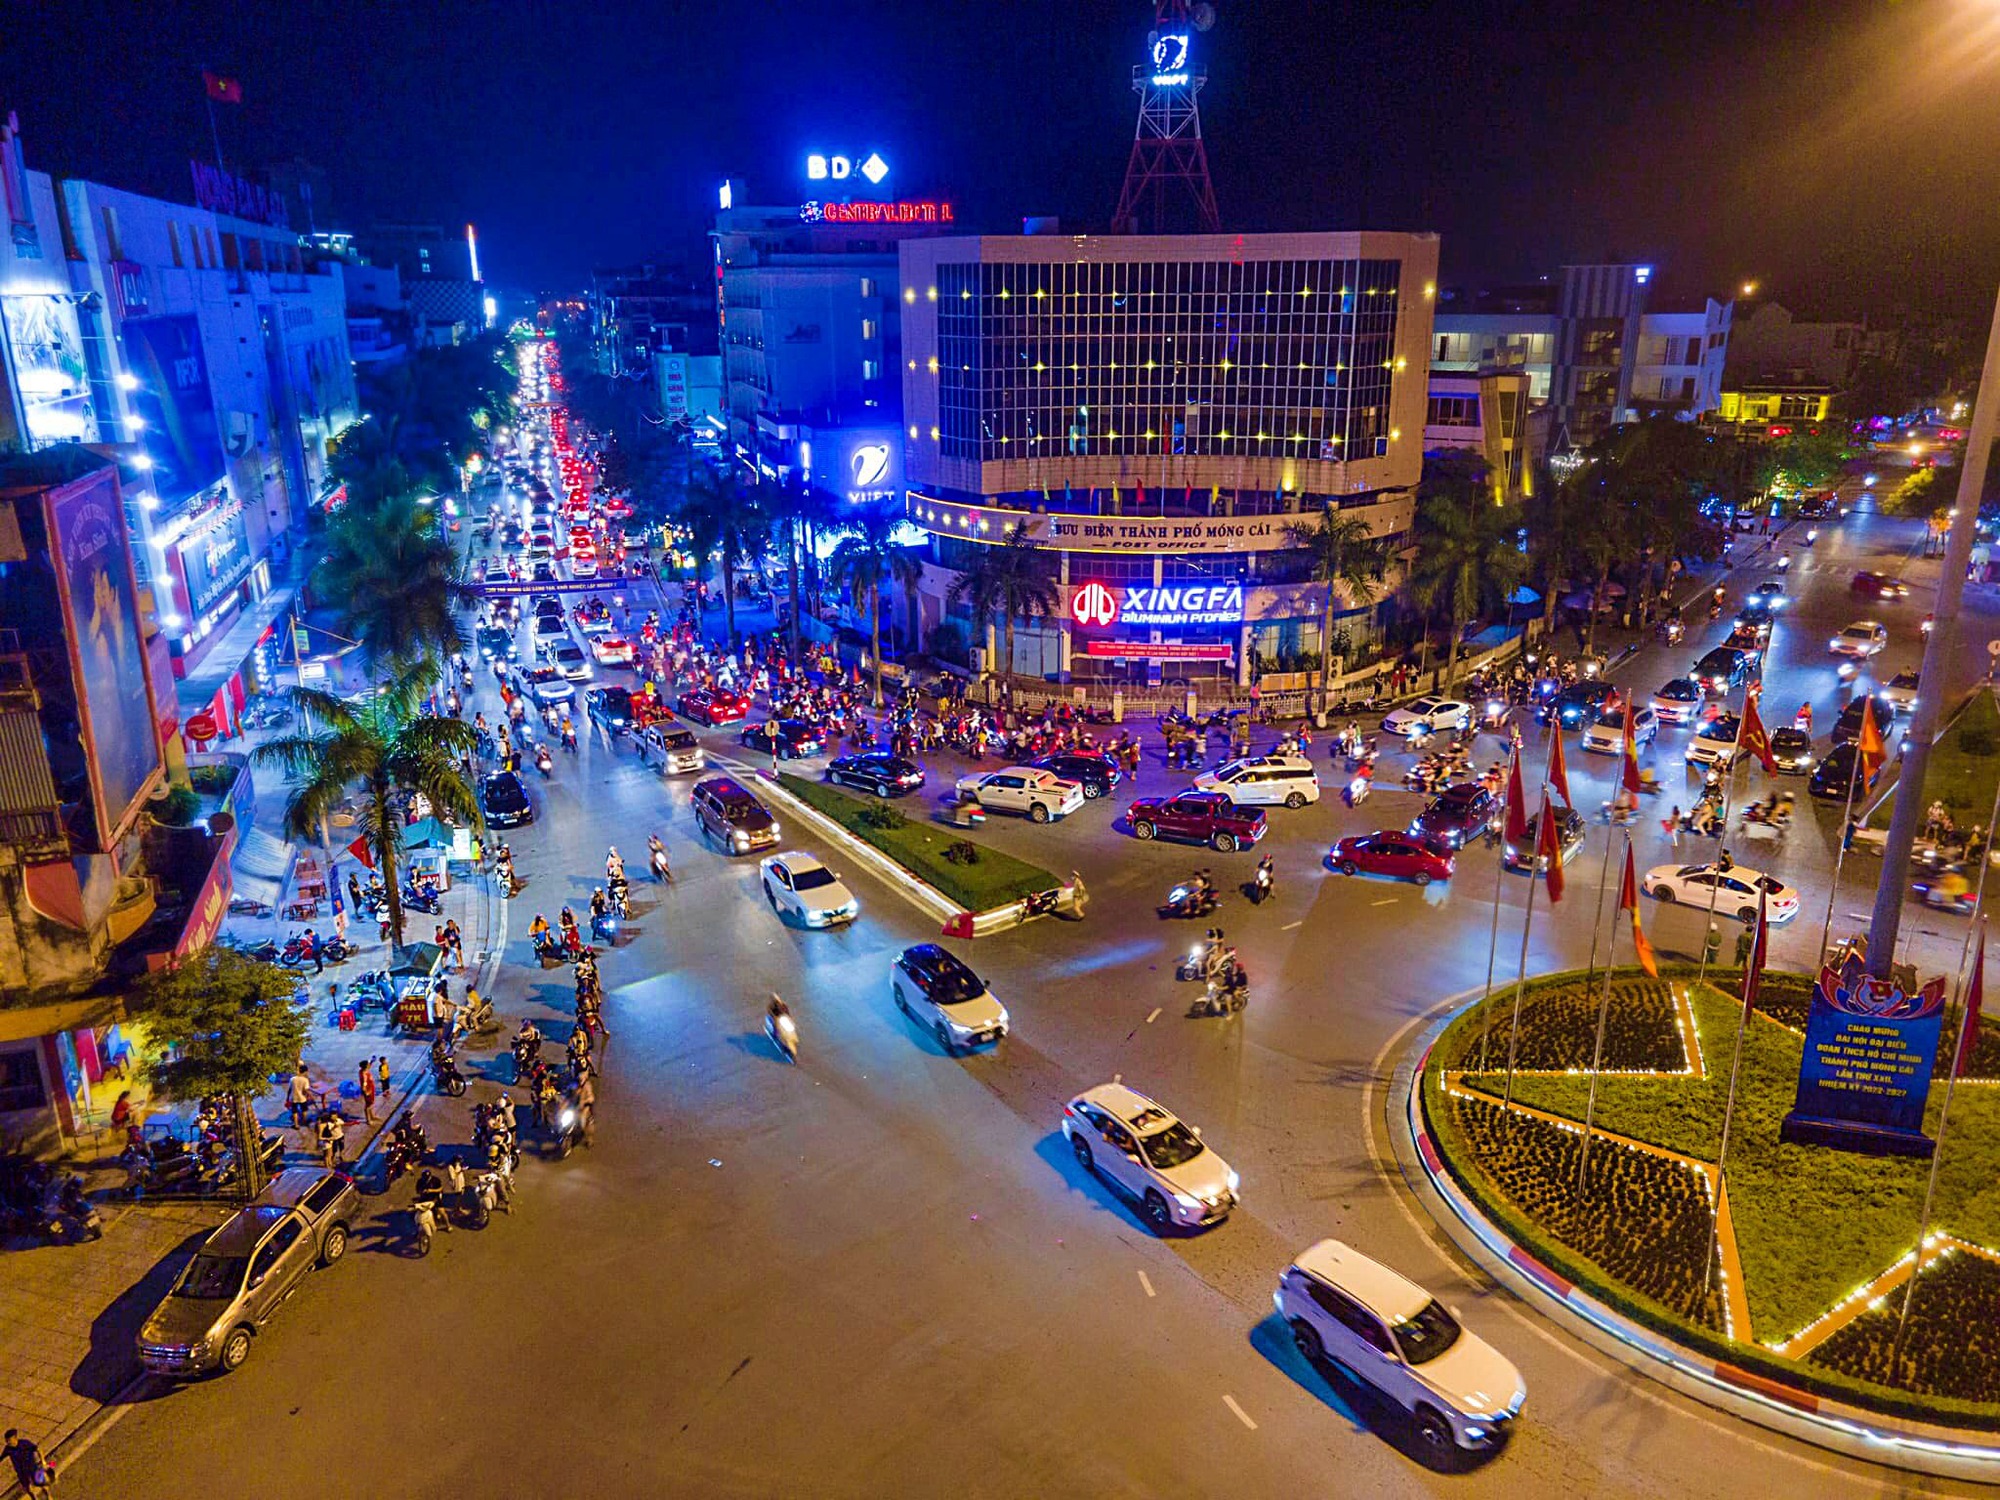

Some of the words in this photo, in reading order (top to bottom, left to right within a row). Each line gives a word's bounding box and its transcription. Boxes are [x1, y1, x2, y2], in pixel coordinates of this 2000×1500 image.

[1119, 522, 1168, 539] THÀNH
[1174, 520, 1203, 539] PHỐ
[1206, 521, 1244, 538] MÓNG
[1249, 520, 1272, 537] CÁI
[1112, 541, 1153, 549] POST
[1157, 541, 1208, 549] OFFICE
[1121, 587, 1242, 611] XINGFA
